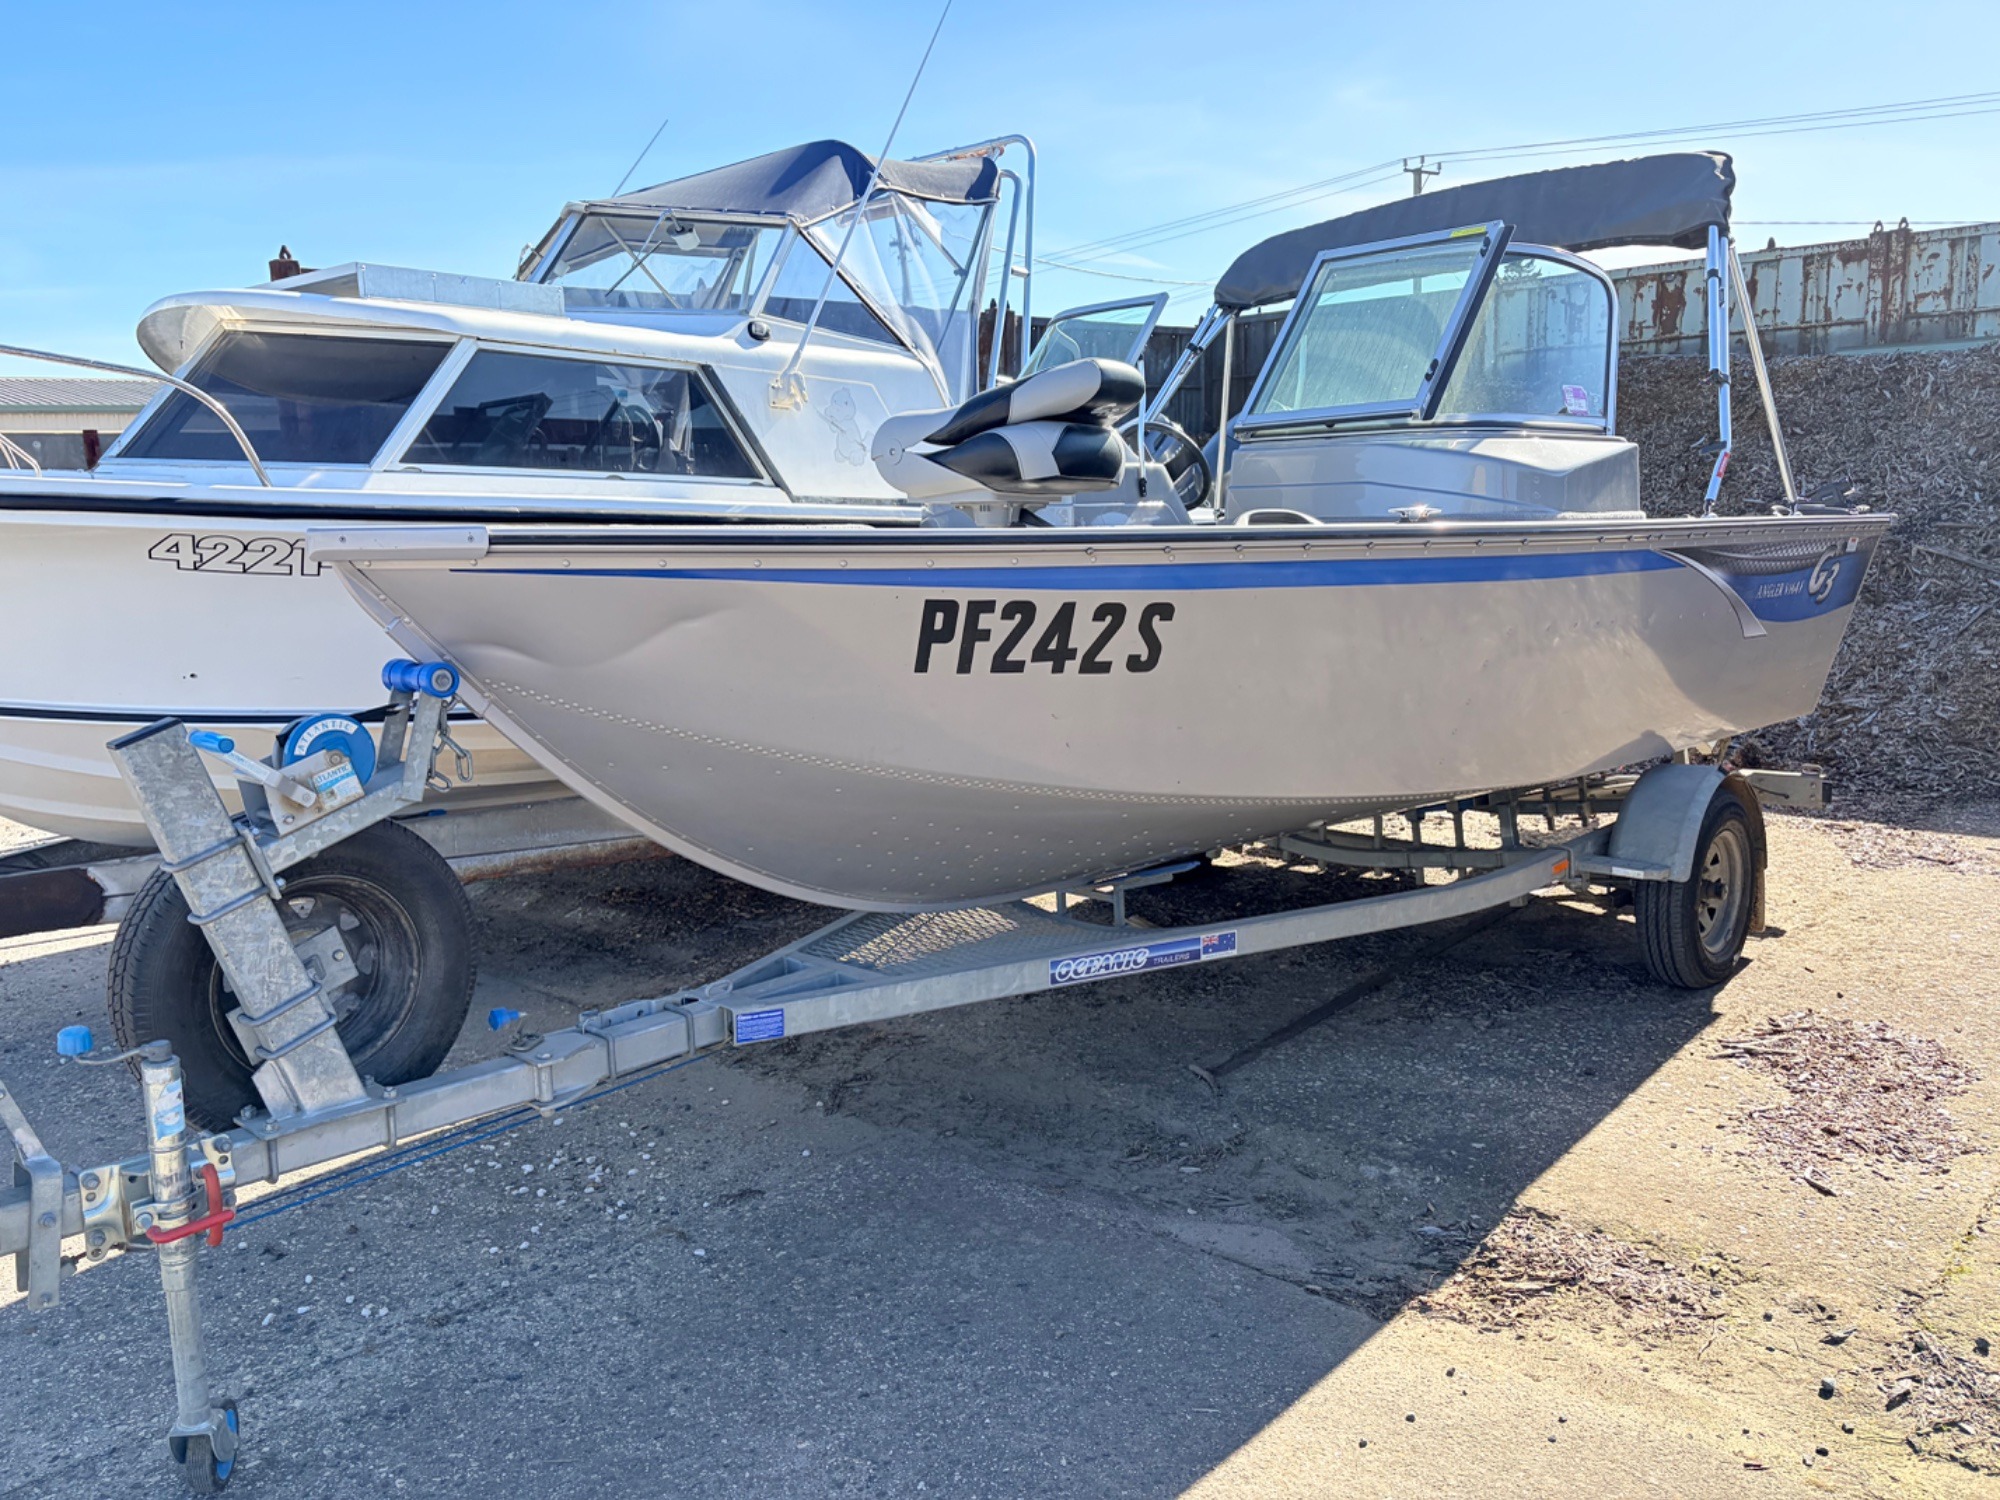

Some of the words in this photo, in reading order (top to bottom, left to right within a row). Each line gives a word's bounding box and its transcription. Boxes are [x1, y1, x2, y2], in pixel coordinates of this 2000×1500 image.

[914, 598, 1176, 674] PF242S
[296, 719, 352, 754] ATLANTIC
[1055, 948, 1150, 982] OCEANIC
[1153, 952, 1191, 966] TRAILERS
